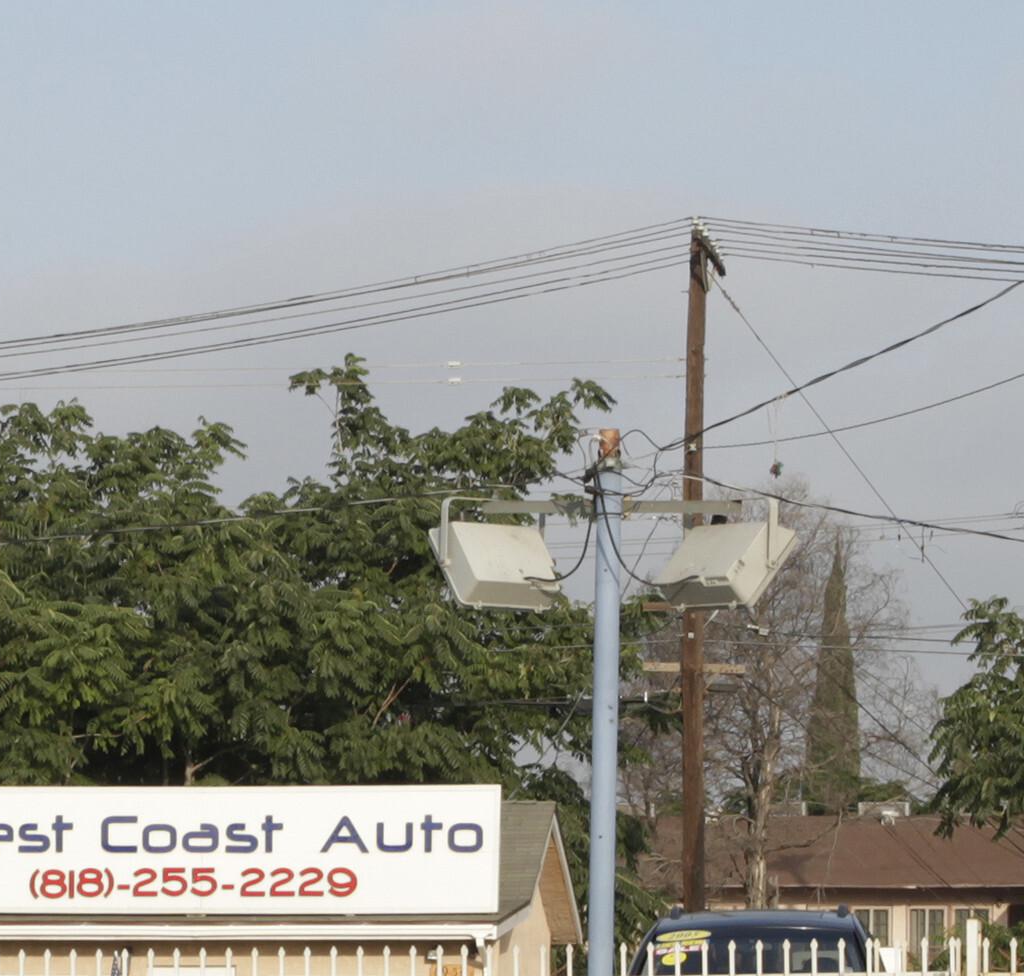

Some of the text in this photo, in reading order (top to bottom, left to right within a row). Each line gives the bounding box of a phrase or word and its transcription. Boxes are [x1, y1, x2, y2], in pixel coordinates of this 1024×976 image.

[99, 814, 284, 854] Coast
[320, 814, 484, 854] Auto
[29, 866, 358, 900] (818)-255-2229
